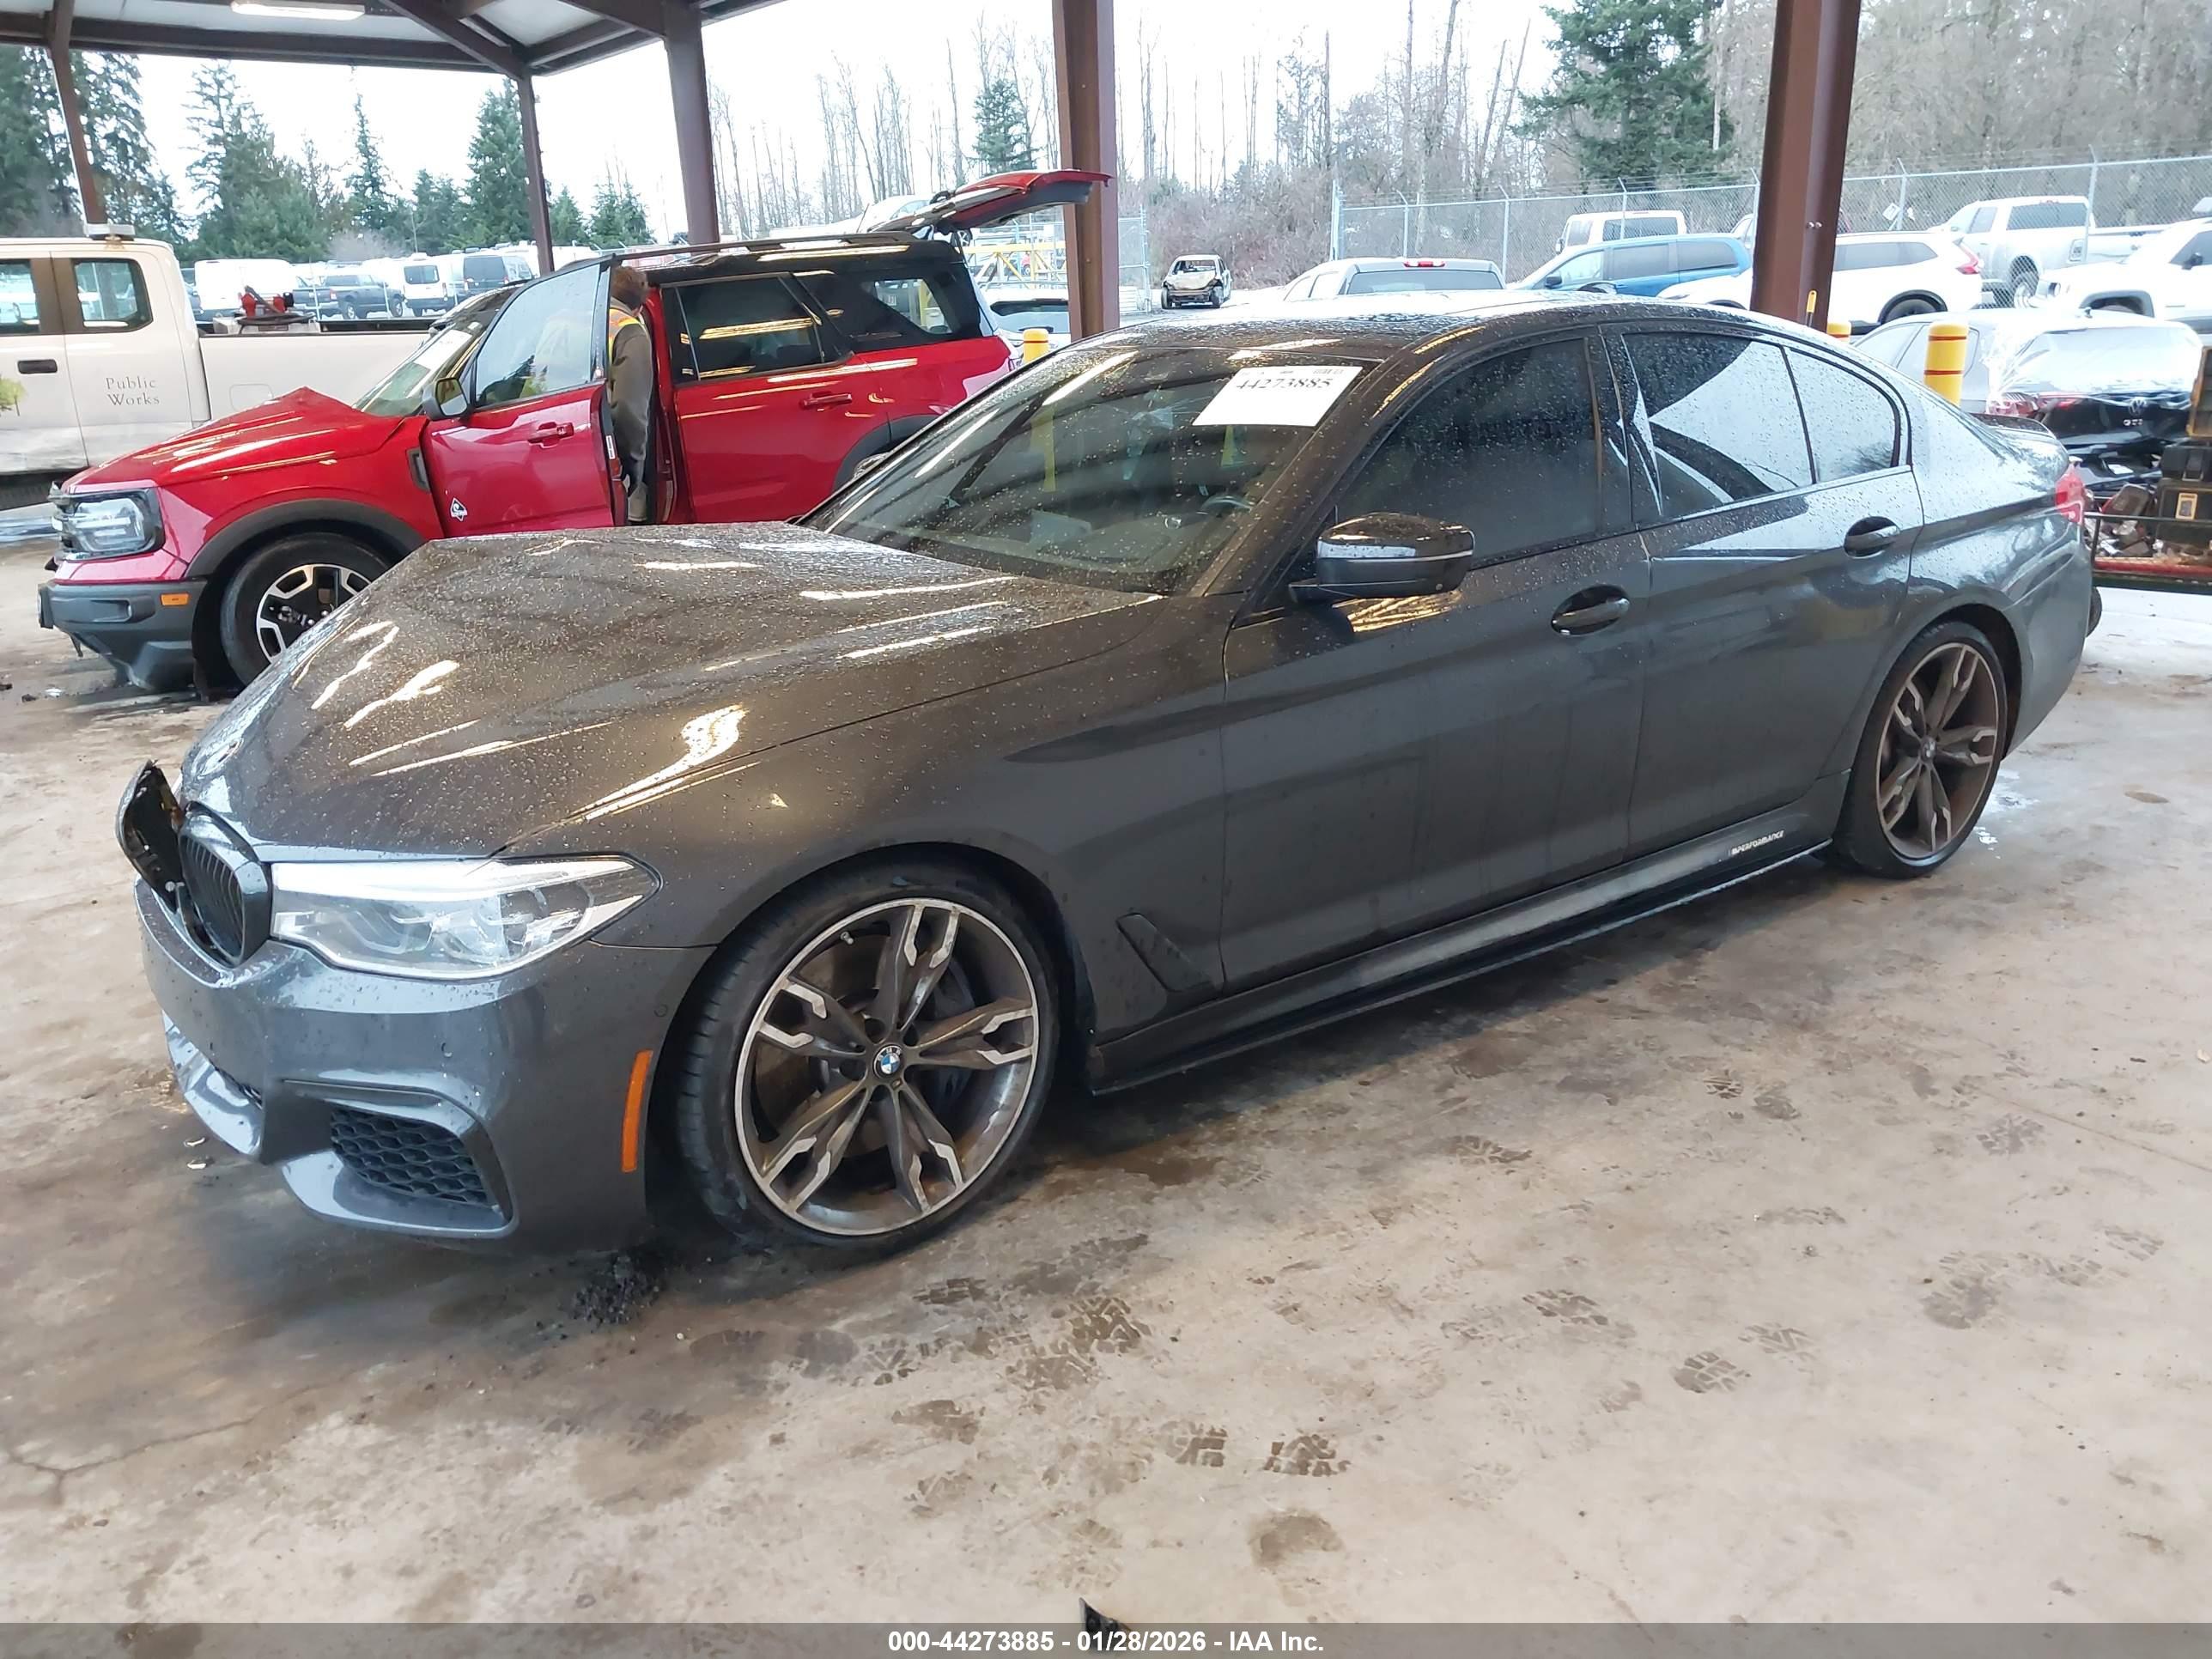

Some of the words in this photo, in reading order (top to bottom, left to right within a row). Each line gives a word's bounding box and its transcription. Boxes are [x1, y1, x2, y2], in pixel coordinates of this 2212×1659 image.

[106, 375, 156, 390] Public
[1237, 378, 1334, 389] 44273885
[106, 392, 160, 405] Works
